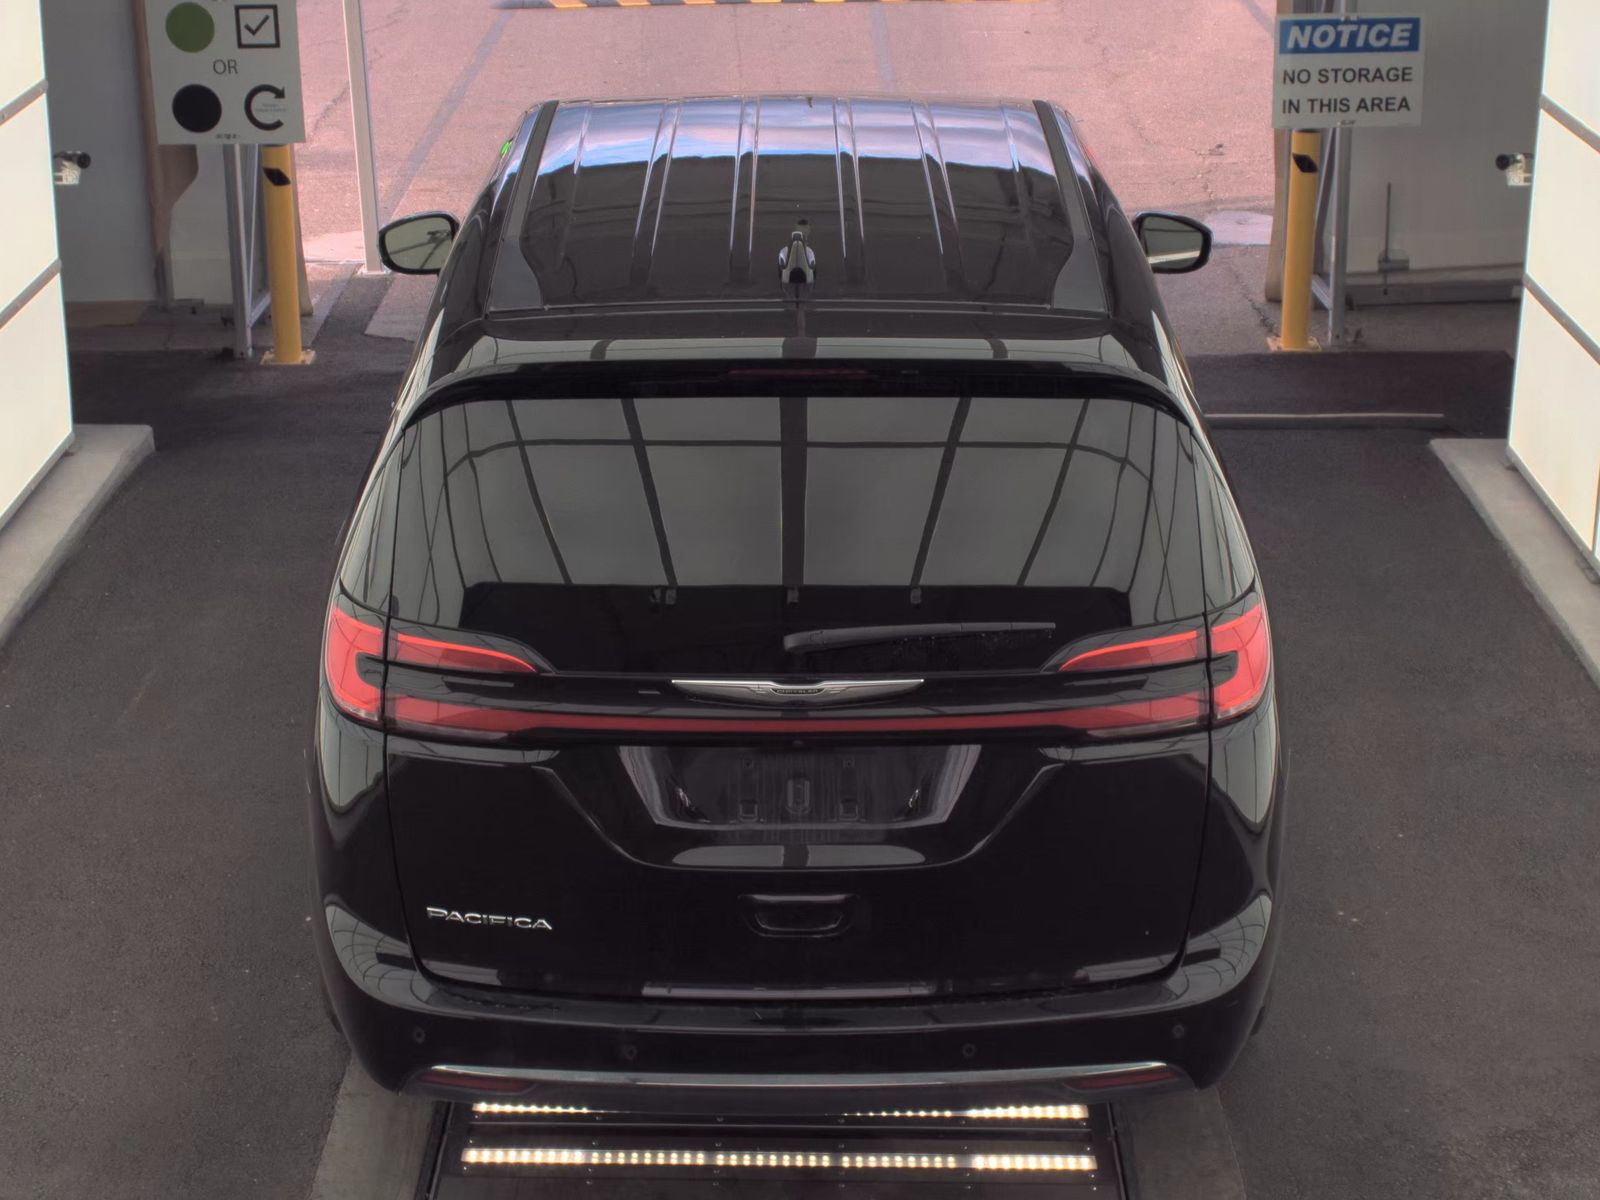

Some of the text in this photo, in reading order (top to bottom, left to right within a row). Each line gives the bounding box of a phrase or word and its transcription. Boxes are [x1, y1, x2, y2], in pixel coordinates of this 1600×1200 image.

[1287, 24, 1412, 48] NOTICE
[213, 59, 238, 75] OR
[1283, 67, 1413, 85] NO STORAGE
[1282, 96, 1411, 114] IN THIS AREA
[426, 907, 552, 930] PACIFICA
